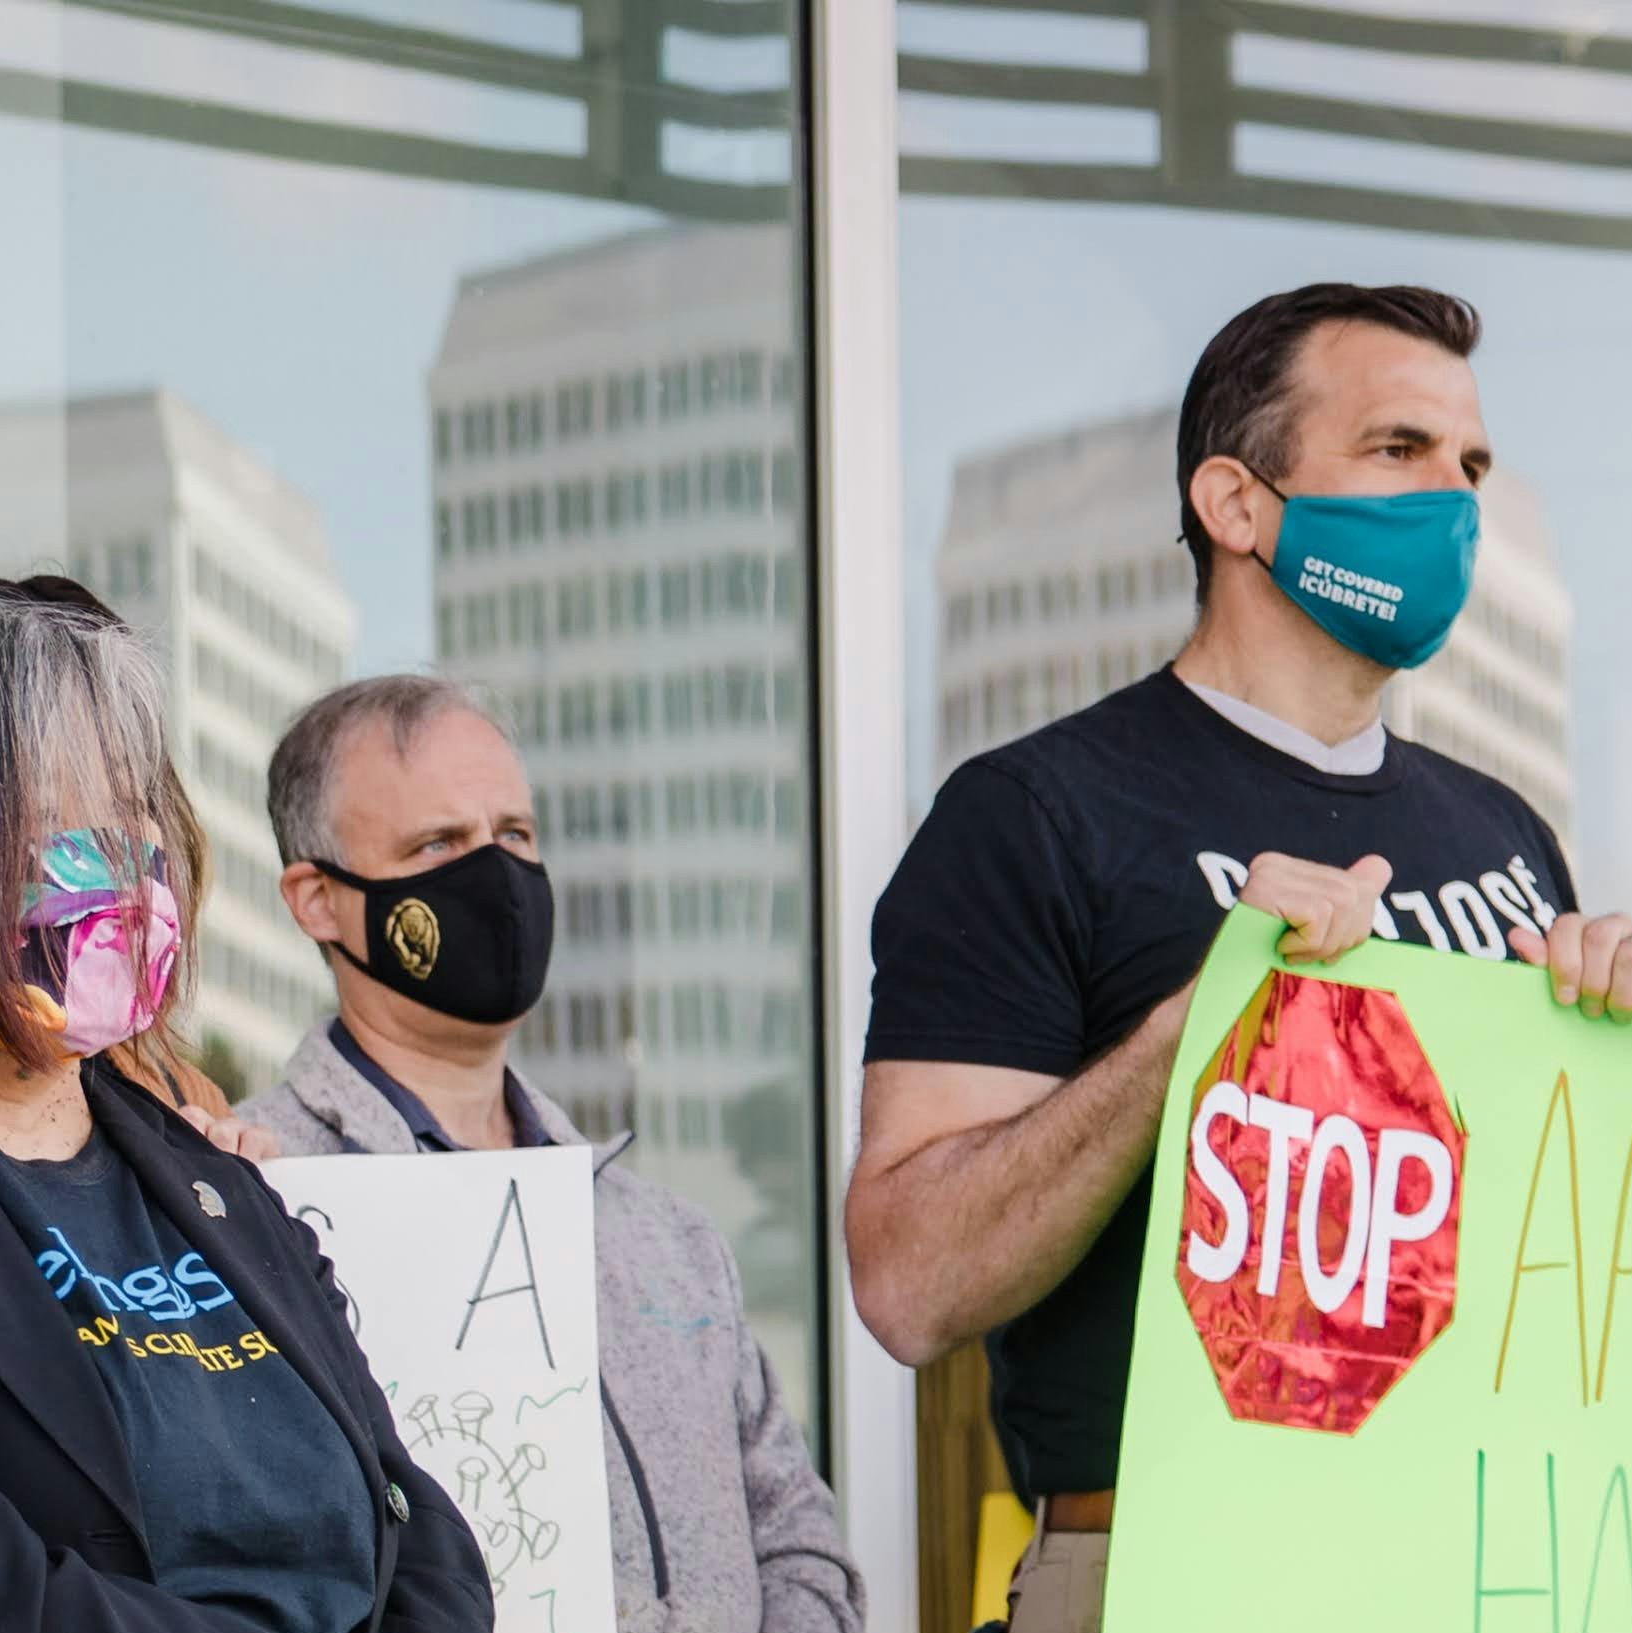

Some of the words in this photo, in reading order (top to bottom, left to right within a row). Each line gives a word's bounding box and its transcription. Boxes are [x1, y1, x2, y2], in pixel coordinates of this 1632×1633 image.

[1304, 555, 1335, 577] GET
[1333, 567, 1404, 602] COVERED
[1186, 1081, 1453, 1329] STOP
